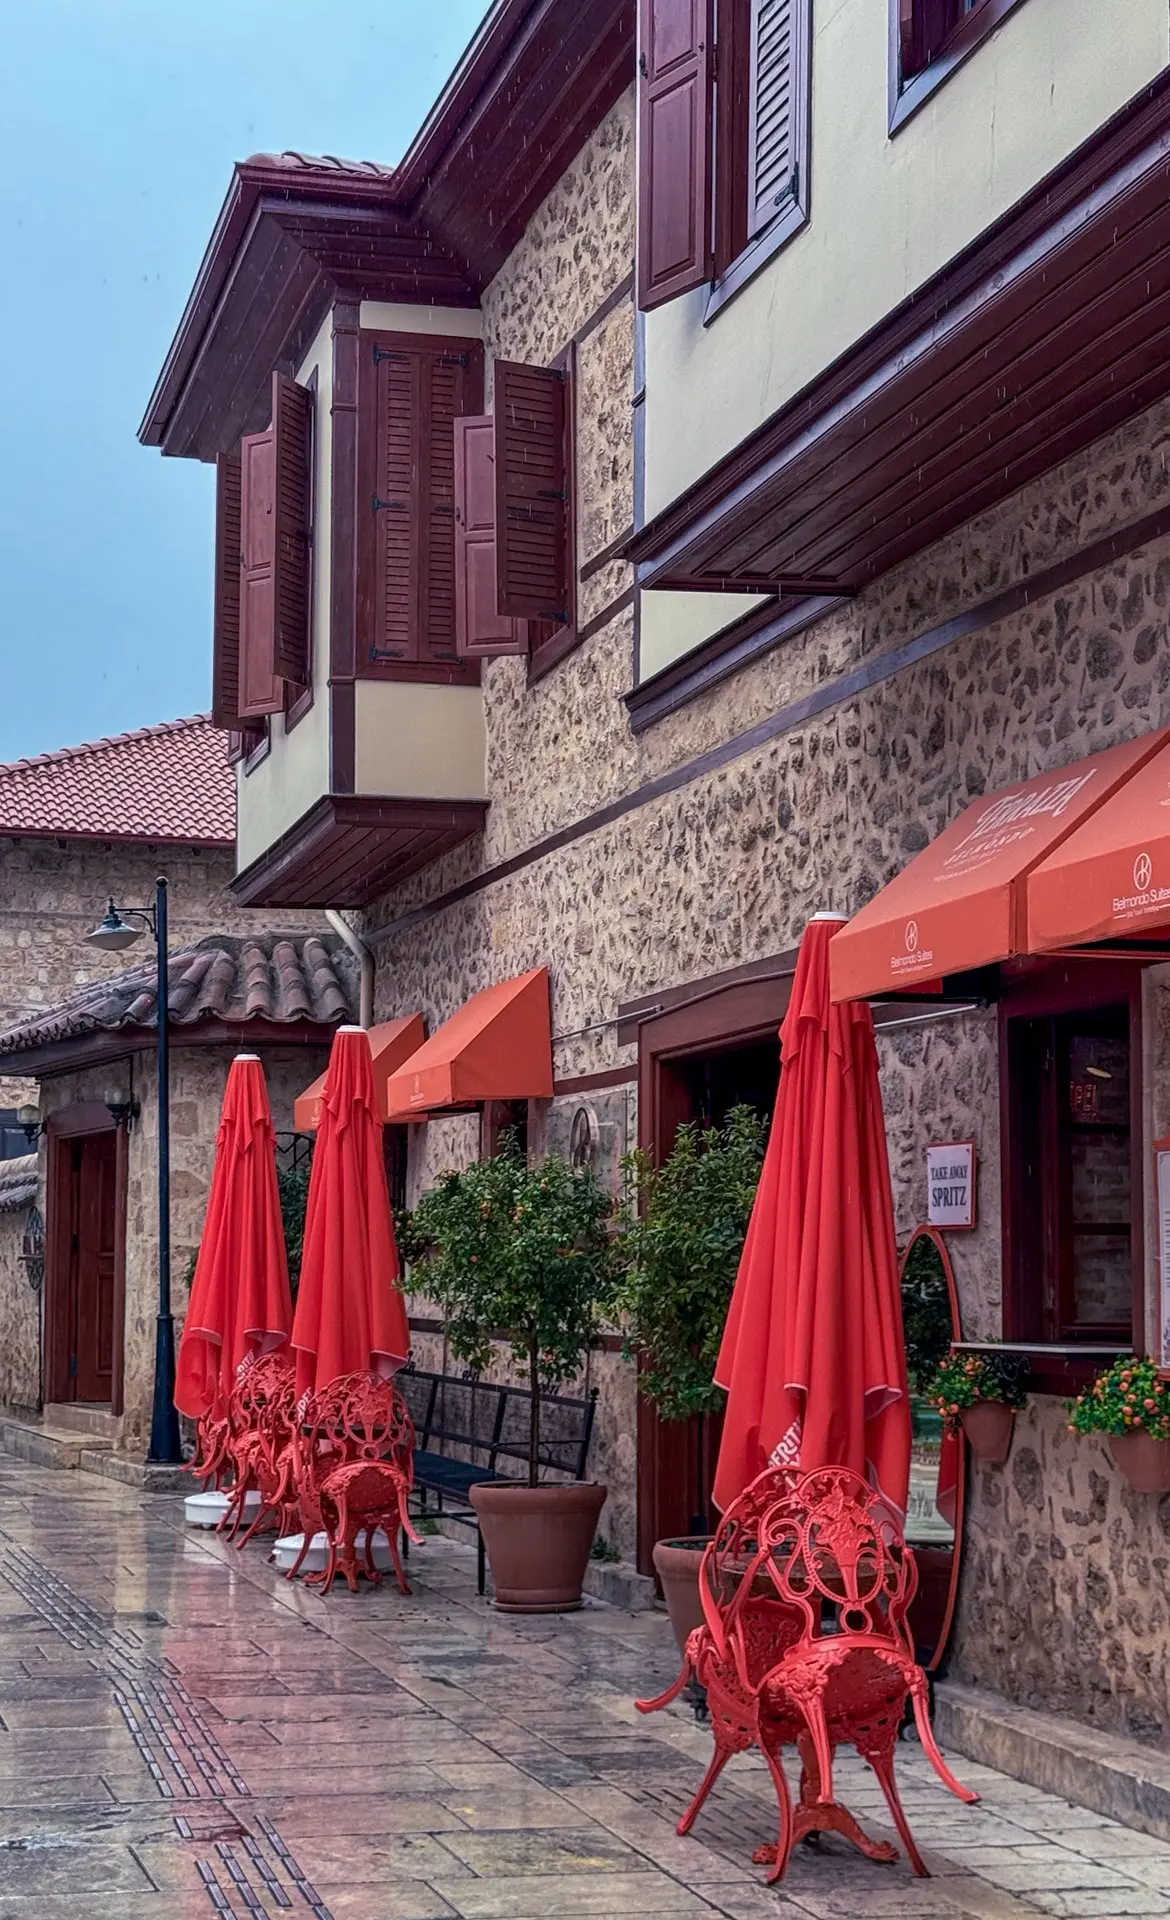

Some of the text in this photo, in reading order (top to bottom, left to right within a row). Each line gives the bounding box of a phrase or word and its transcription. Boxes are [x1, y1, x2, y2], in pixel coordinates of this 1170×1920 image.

[1112, 893, 1149, 912] Belmondo
[931, 1165, 968, 1180] TAKE AWAY
[932, 1186, 967, 1207] SPRITZ
